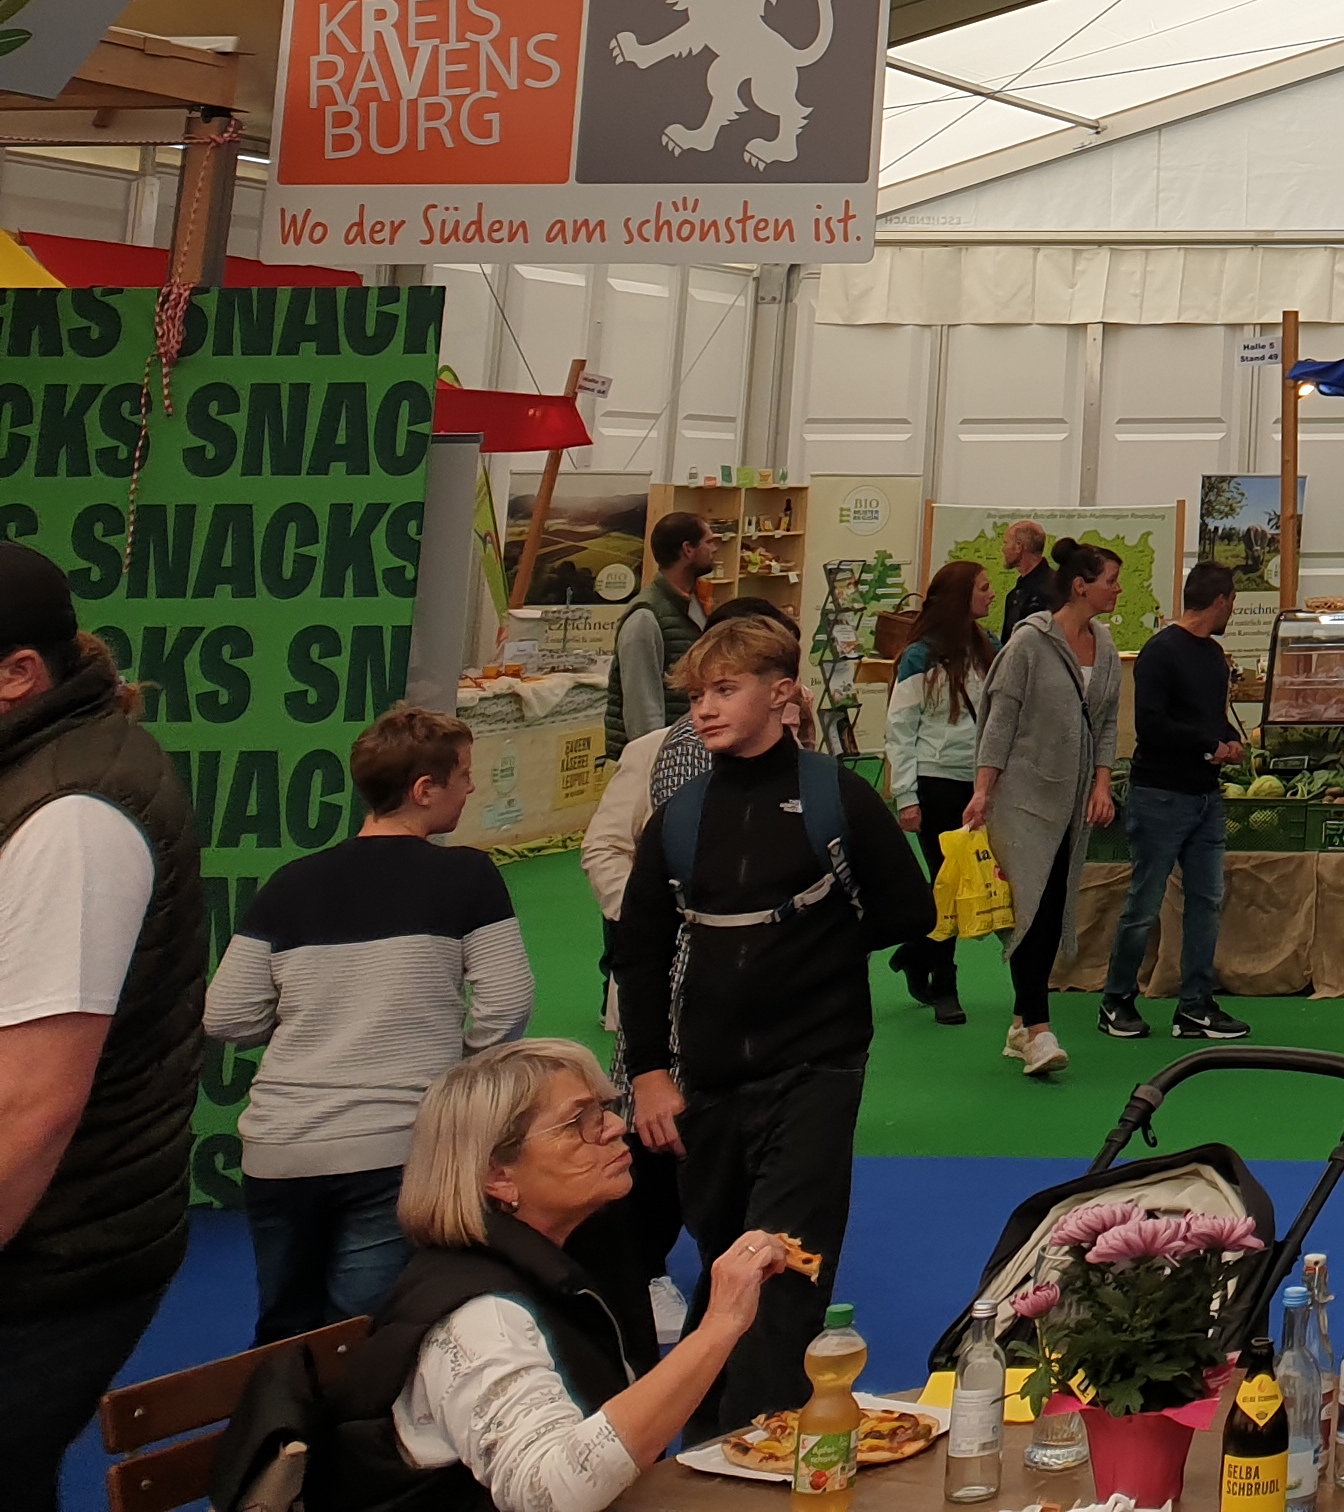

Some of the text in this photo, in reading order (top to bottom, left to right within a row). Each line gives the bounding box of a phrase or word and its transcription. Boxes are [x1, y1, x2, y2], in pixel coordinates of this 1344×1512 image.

[309, 33, 561, 109] RAVENS
[324, 90, 501, 159] BURG
[279, 196, 863, 247] Wo der Süden am schönsten ist.
[1240, 354, 1266, 363] Stand
[1243, 343, 1267, 351] Halle
[1227, 1463, 1260, 1480] GELBA
